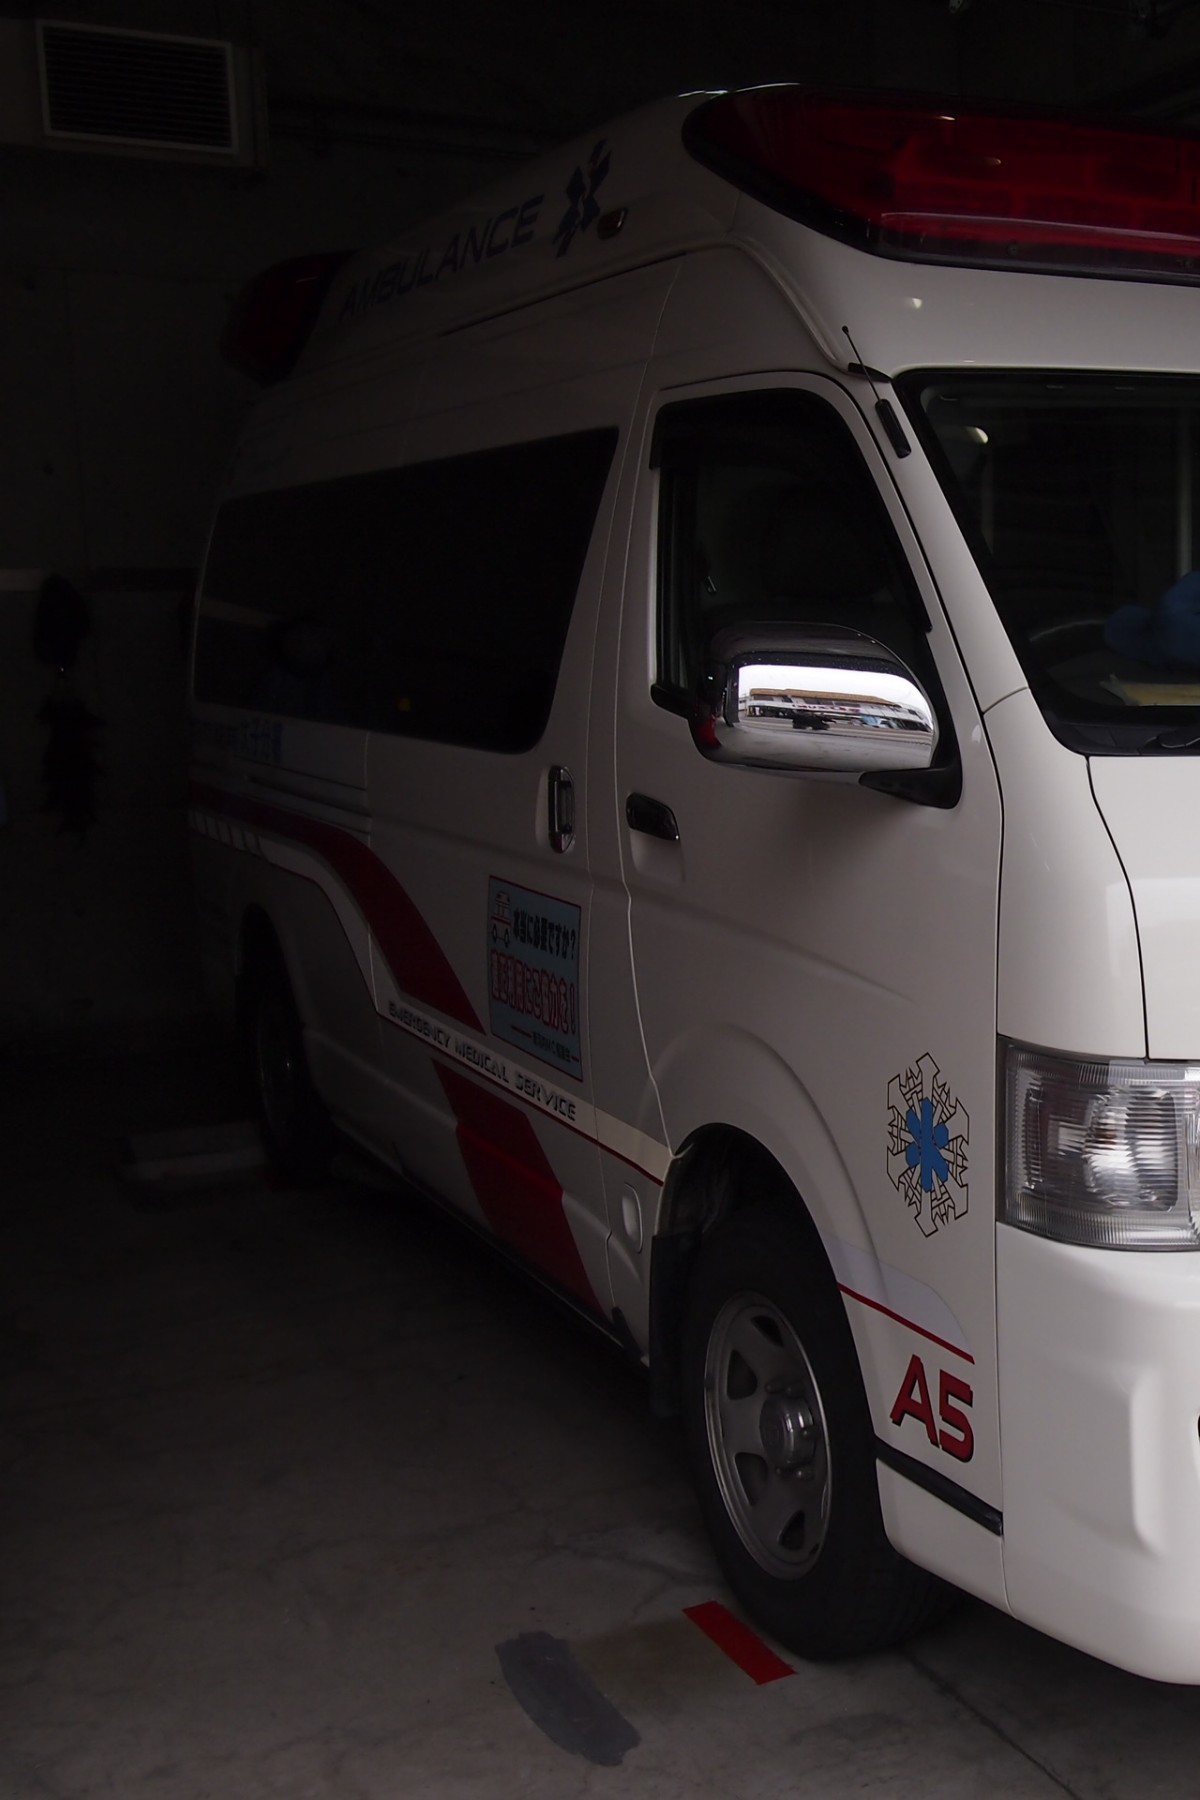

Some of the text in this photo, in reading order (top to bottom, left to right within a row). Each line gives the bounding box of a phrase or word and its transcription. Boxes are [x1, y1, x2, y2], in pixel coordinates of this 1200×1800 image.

[338, 194, 545, 323] AMBULANCE
[388, 1001, 451, 1049] EMERGENCY
[454, 1040, 510, 1084] MEDICAL
[515, 1071, 576, 1122] SERVICE
[889, 1353, 974, 1463] A5
